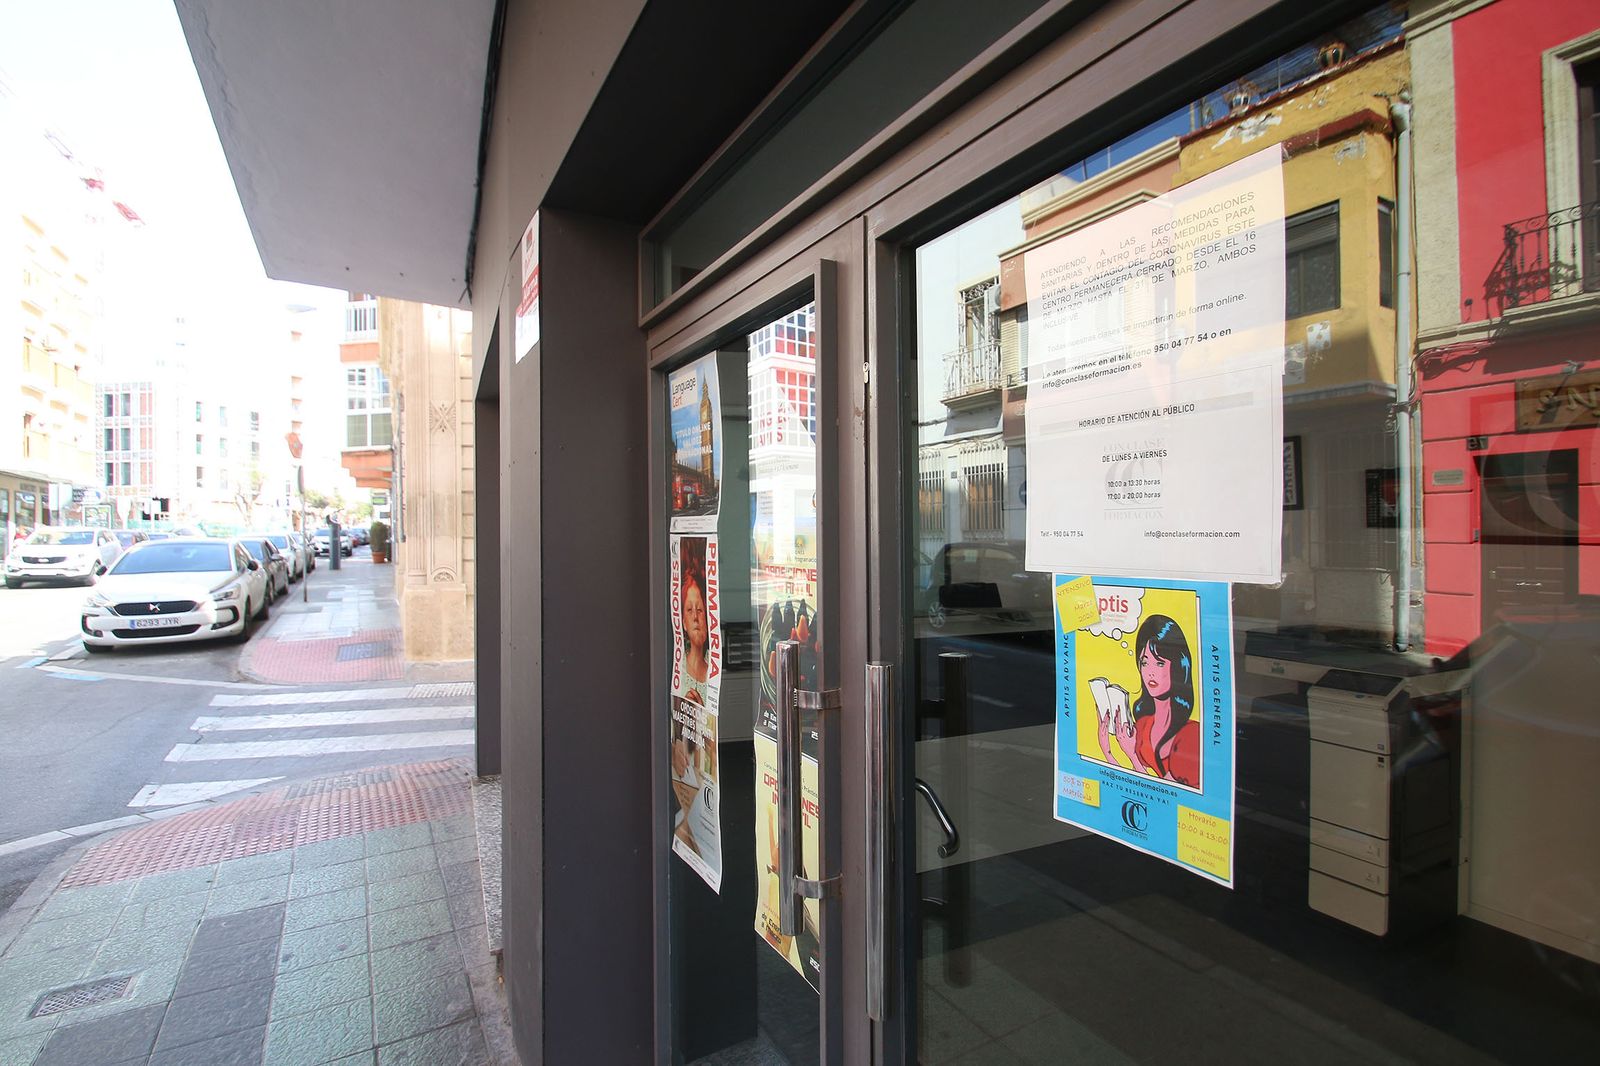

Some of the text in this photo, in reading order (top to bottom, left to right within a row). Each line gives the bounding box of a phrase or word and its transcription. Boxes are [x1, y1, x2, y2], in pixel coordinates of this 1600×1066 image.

[1041, 256, 1087, 279] ATENDIENDO
[1120, 236, 1136, 250] LAS
[1151, 191, 1255, 237] RECOMENDACIONES
[1041, 268, 1083, 290] SANITARIAS
[1096, 250, 1130, 270] DENTRO
[1134, 243, 1147, 255] DE
[1151, 235, 1169, 249] LAS
[1174, 217, 1219, 240] MEDIDAS
[1225, 205, 1255, 222] PARA
[1042, 285, 1066, 300] EVITAR
[1083, 264, 1124, 285] CONTAGIO
[1128, 256, 1145, 268] DEL
[1150, 229, 1221, 260] CORONAVIRUS
[1227, 217, 1256, 234] ESTE
[1042, 294, 1072, 310] CENTRO
[1136, 256, 1182, 277] CERRADO
[1186, 242, 1221, 260] DESDE
[1225, 237, 1239, 248] EL
[1245, 230, 1256, 241] 16
[1152, 273, 1165, 284] DE
[1217, 244, 1256, 264] AMBOS
[1176, 309, 1187, 319] de
[1189, 303, 1214, 316] forma
[1216, 293, 1247, 307] online.
[1154, 343, 1169, 353] 950
[1171, 339, 1182, 349] 04
[1184, 336, 1195, 346] 77
[1197, 333, 1208, 342] 54
[1210, 331, 1217, 339] o
[1219, 328, 1232, 337] en
[673, 378, 696, 396] Language
[672, 395, 682, 408] Cert
[1079, 403, 1195, 428] HORARIO DE ATENCIÓN AL PÚBLICO
[1111, 453, 1132, 462] LUNES
[1139, 449, 1168, 459] VIERNES
[764, 565, 817, 582] OPOSICIONE
[707, 542, 720, 679] PRIMARIA
[1098, 594, 1129, 615] ptis
[136, 617, 180, 628] 6293 JYR
[672, 560, 683, 690] OPOSICIONES
[1211, 645, 1221, 746] APTIS GENERAL
[1125, 787, 1153, 801] RESERVA
[1188, 812, 1216, 828] Horario
[1178, 821, 1197, 834] 10:00
[1206, 832, 1229, 845] 13:00
